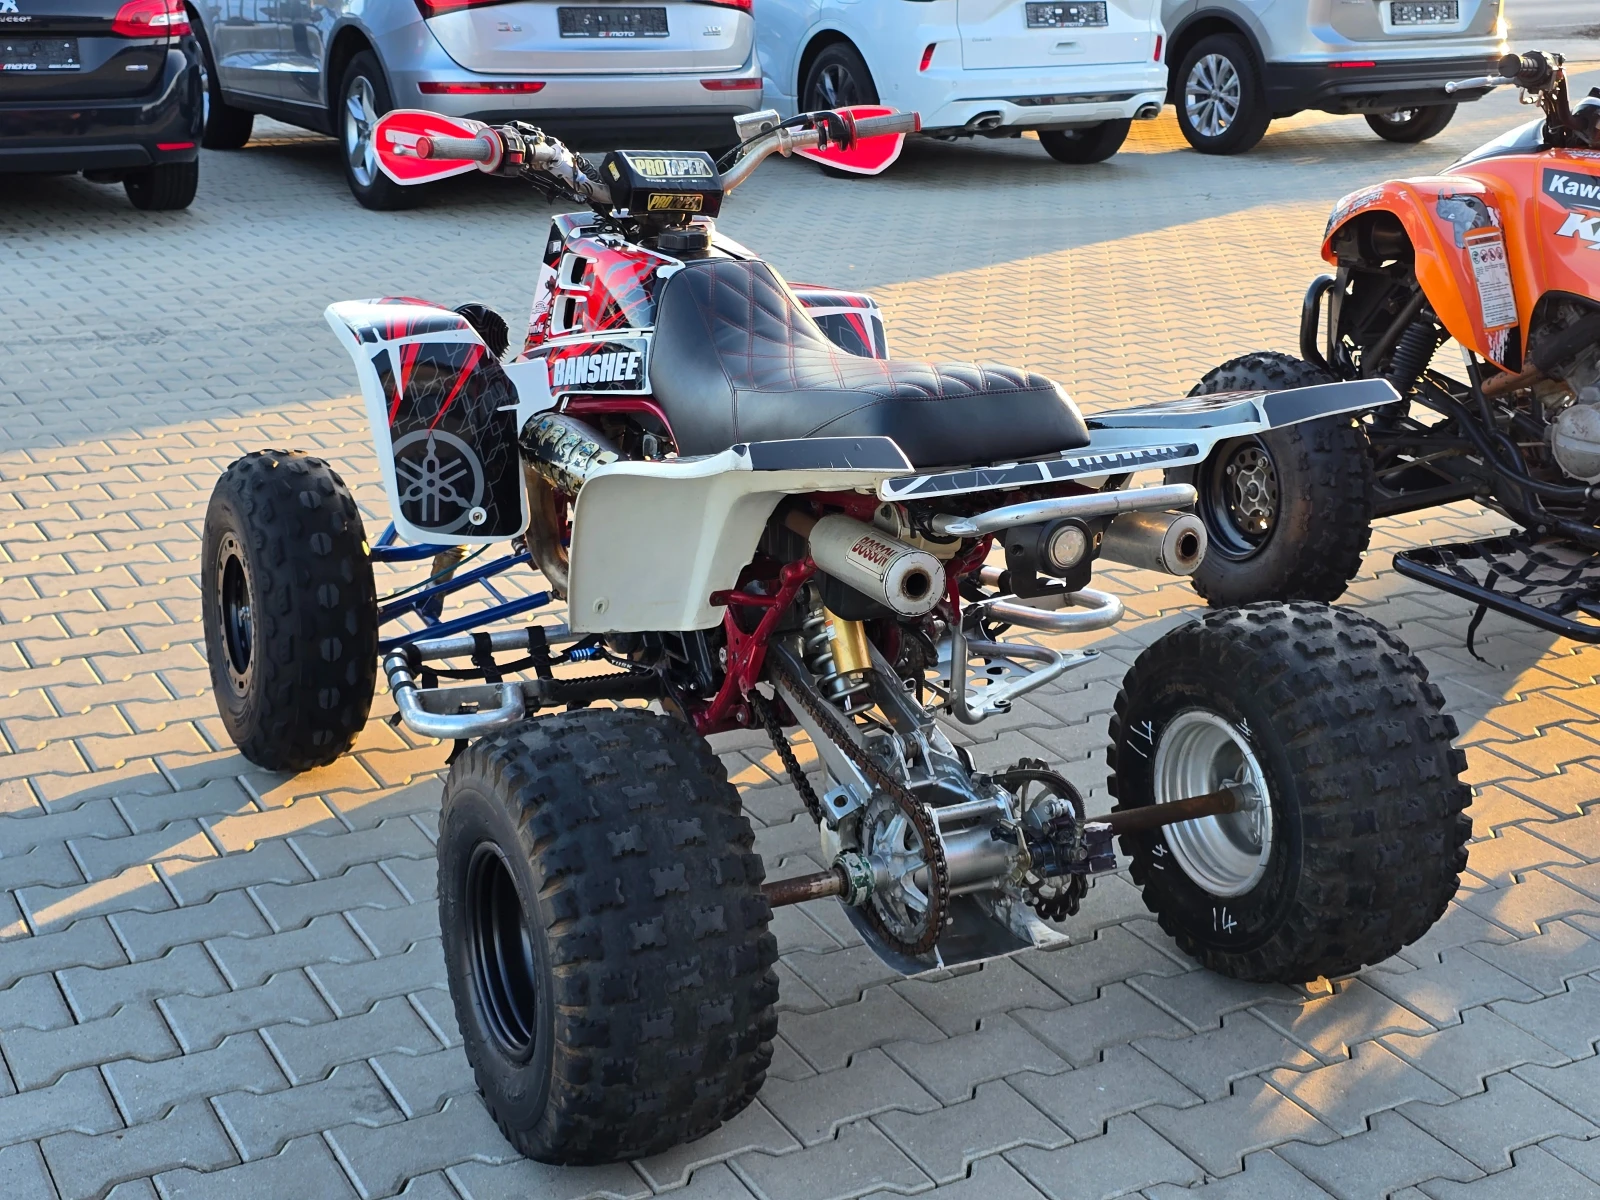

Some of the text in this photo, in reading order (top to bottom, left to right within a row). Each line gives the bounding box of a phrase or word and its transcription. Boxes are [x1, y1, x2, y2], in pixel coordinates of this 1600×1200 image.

[634, 159, 706, 176] PROTAPER
[553, 352, 642, 387] BANSHEE
[1127, 720, 1155, 758] 14
[1152, 843, 1167, 870] 14
[1213, 906, 1237, 934] 14
